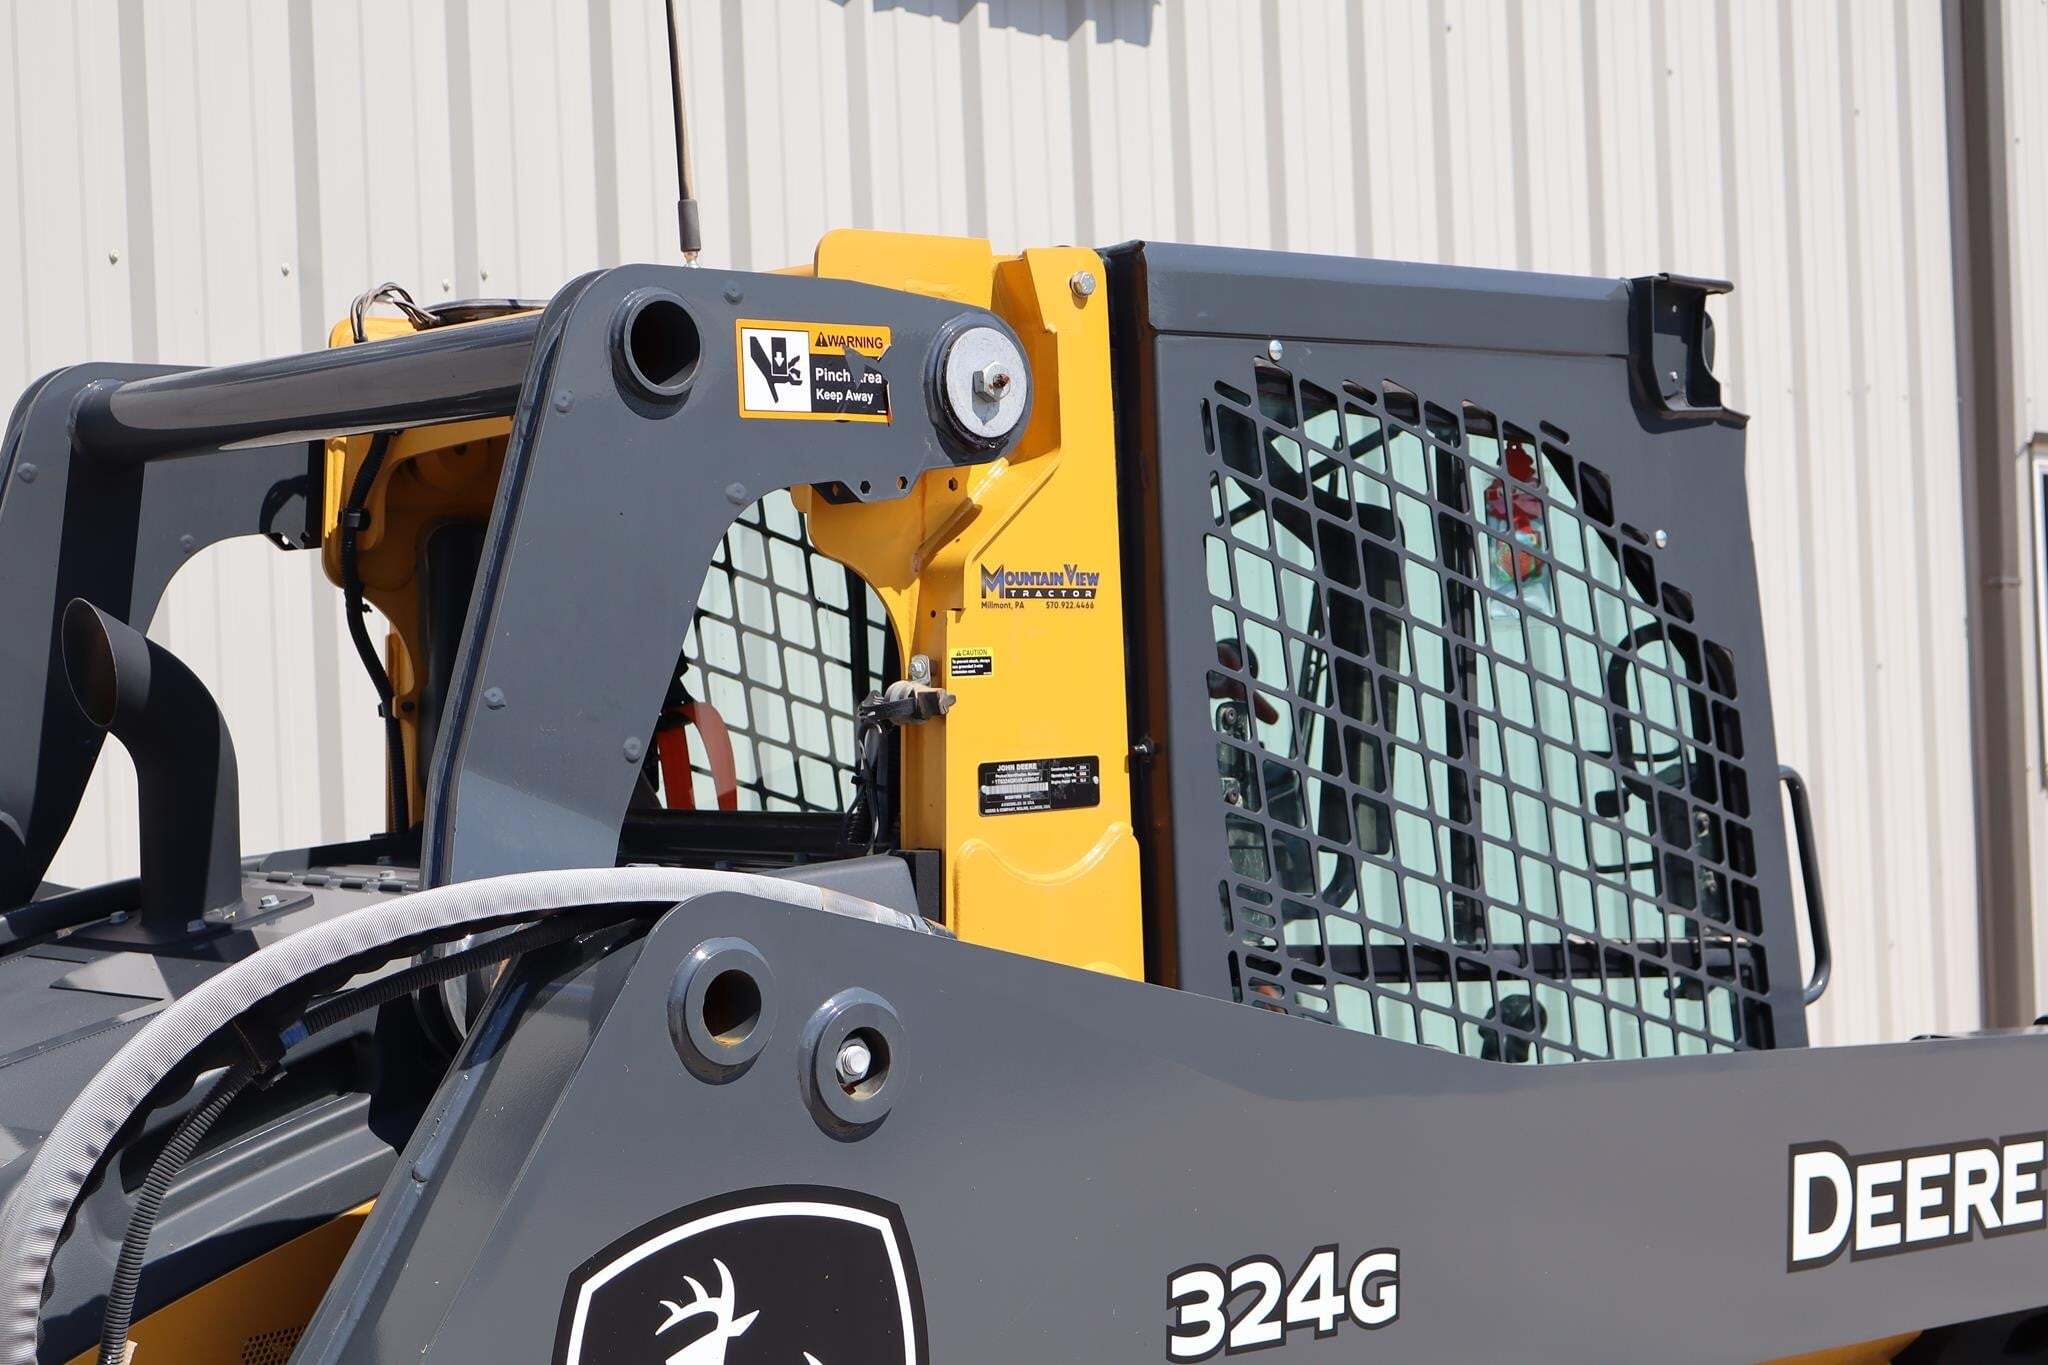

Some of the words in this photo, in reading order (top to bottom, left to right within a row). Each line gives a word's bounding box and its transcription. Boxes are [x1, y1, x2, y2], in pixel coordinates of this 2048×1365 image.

[827, 335, 884, 349] WARNING
[815, 367, 851, 382] Pinch
[853, 371, 882, 384] rea
[816, 388, 843, 403] Keep
[845, 389, 874, 405] Away
[1010, 590, 1092, 598] TRACTOR
[981, 601, 1013, 609] Millmont,
[1015, 601, 1025, 609] PA
[1046, 601, 1094, 609] 570.922.4466
[997, 764, 1015, 772] JOHN
[1016, 763, 1038, 771] DEERE
[1791, 1141, 2045, 1262] DEERE
[1168, 1249, 1399, 1359] 324G
